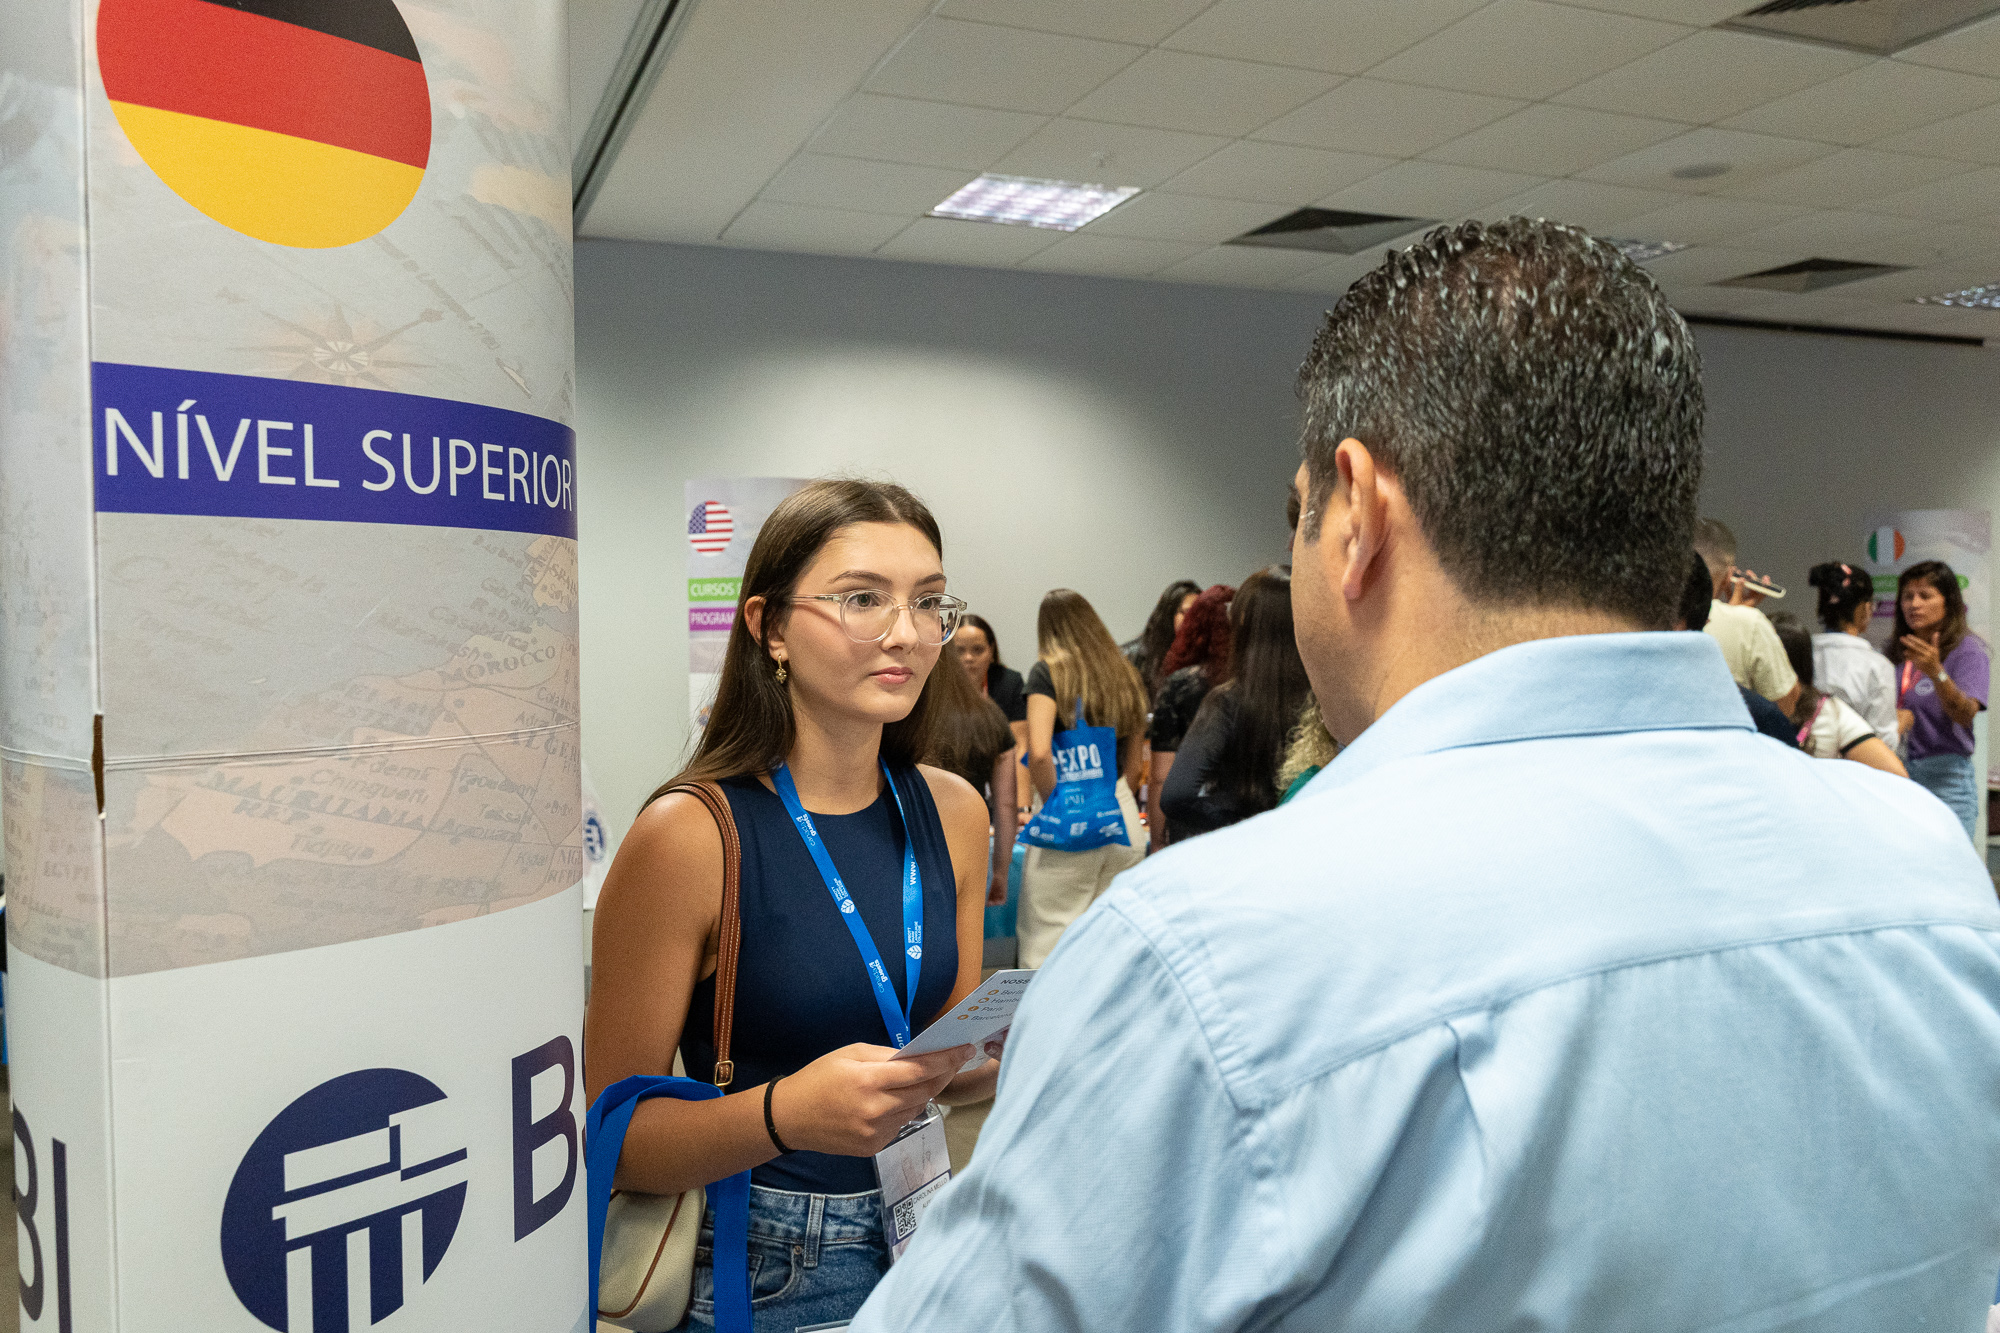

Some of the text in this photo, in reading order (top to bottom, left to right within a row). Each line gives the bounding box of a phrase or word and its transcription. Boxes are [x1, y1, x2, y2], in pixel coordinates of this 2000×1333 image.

[105, 399, 572, 512] NÍVEL SUPERIOR
[690, 583, 735, 597] CURSOS
[690, 612, 736, 625] PROGRAM
[437, 645, 556, 685] MOROCCO
[1057, 743, 1102, 772] EXPO
[803, 814, 817, 836] guests
[874, 959, 888, 983] guests
[511, 1010, 587, 1243] B
[913, 1186, 933, 1204] CAROLINA
